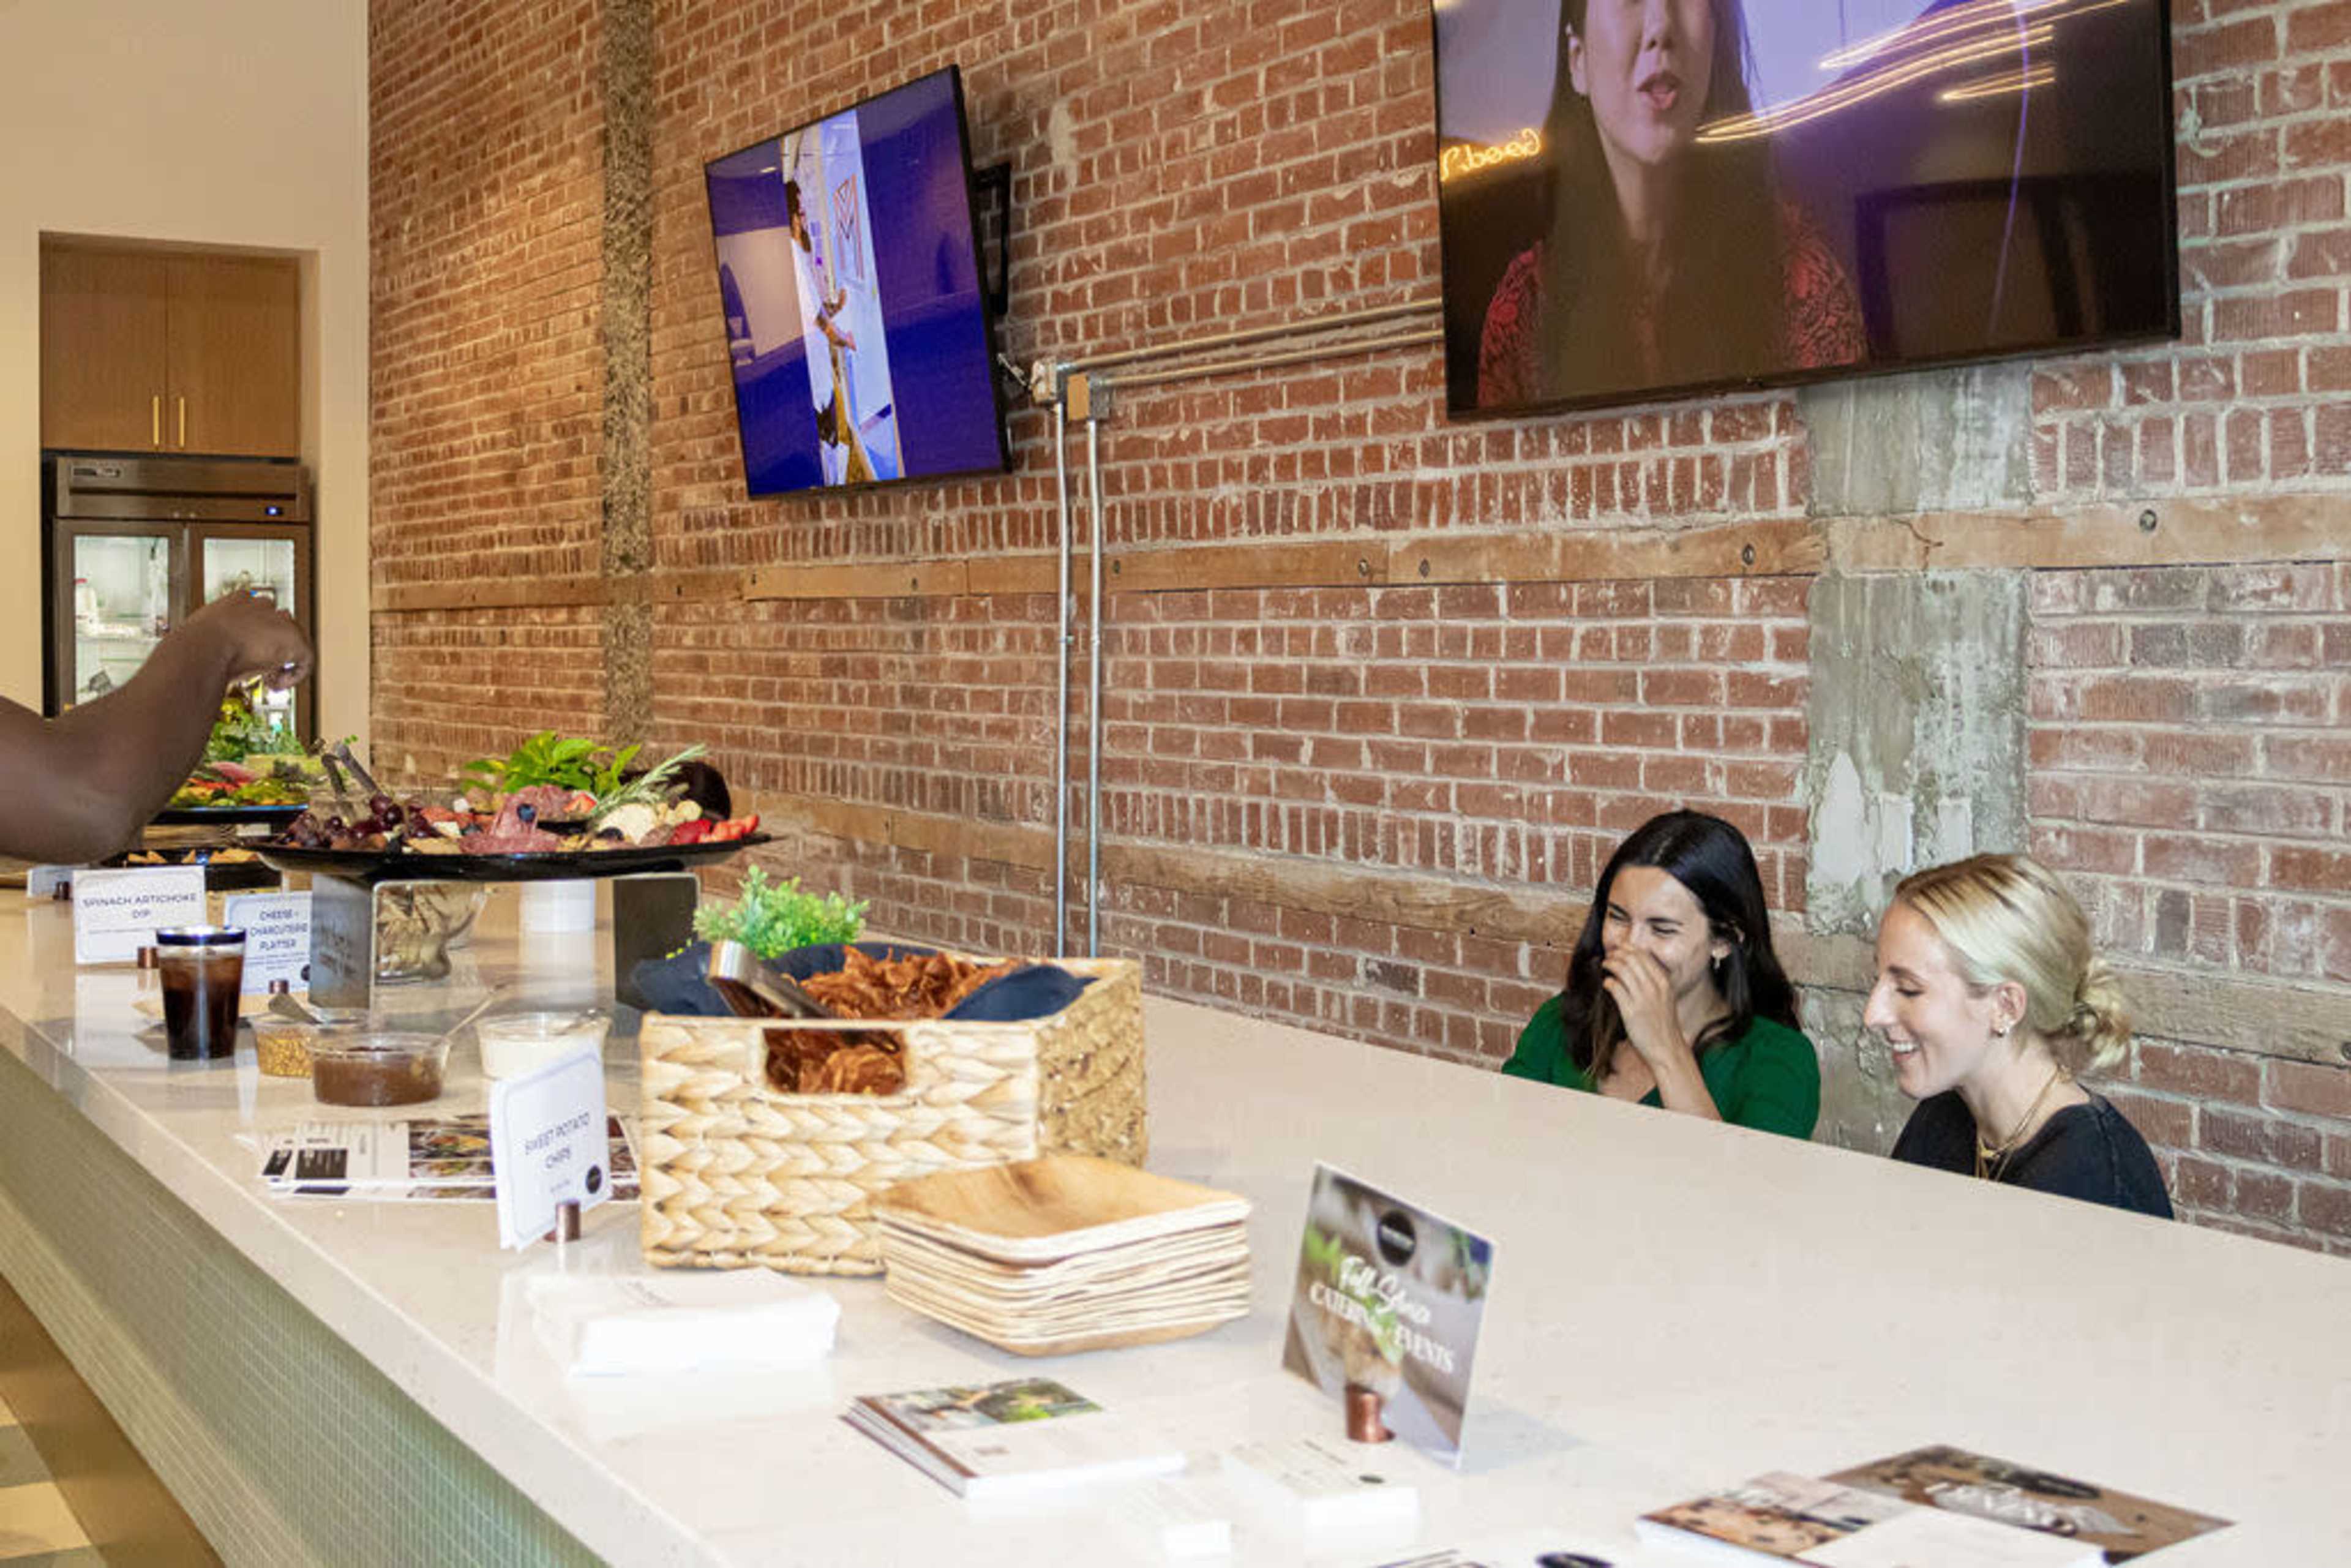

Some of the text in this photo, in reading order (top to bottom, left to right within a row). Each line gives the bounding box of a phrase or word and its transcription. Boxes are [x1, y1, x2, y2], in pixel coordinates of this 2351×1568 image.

[83, 893, 196, 907] SPINACH ARTICHOKE
[132, 909, 150, 918] DIP
[260, 939, 296, 950] PLATTER
[525, 1112, 590, 1155] SWEET POTATO
